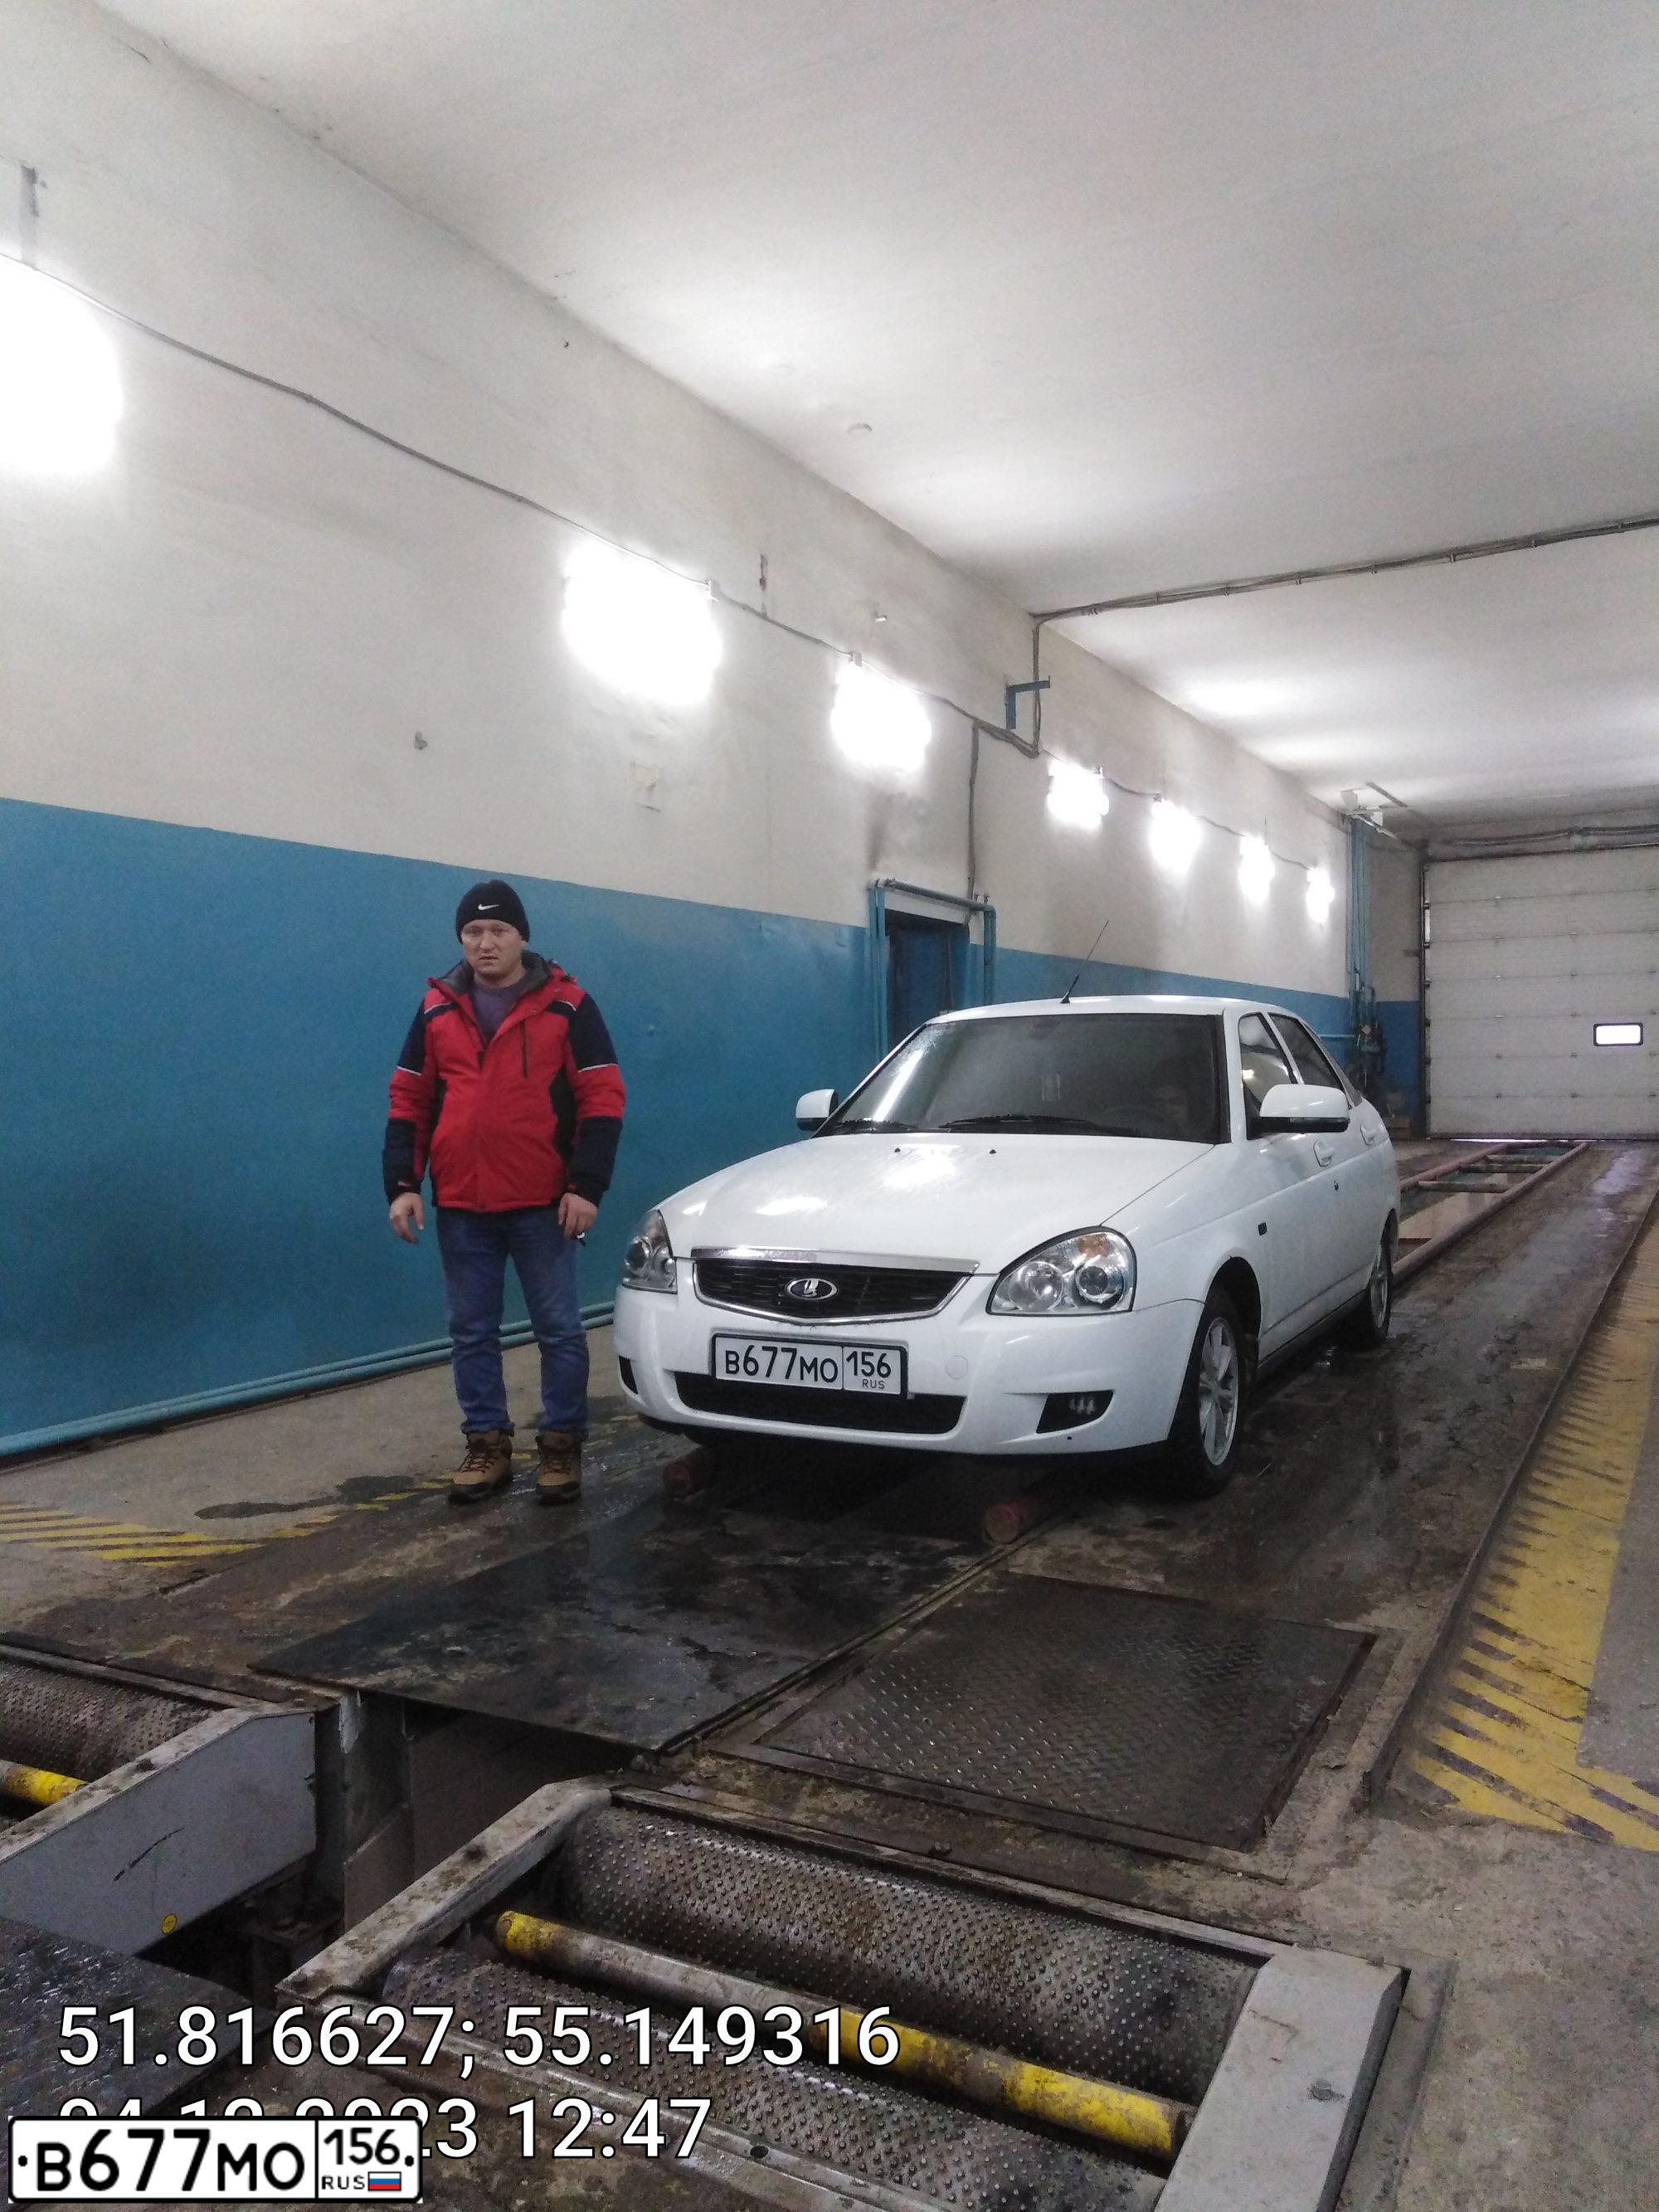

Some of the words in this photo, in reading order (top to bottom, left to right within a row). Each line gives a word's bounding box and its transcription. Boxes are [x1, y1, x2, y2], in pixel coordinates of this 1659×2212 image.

[725, 1344, 839, 1383] В677МО
[845, 1350, 892, 1379] 156
[861, 1378, 885, 1390] RUS
